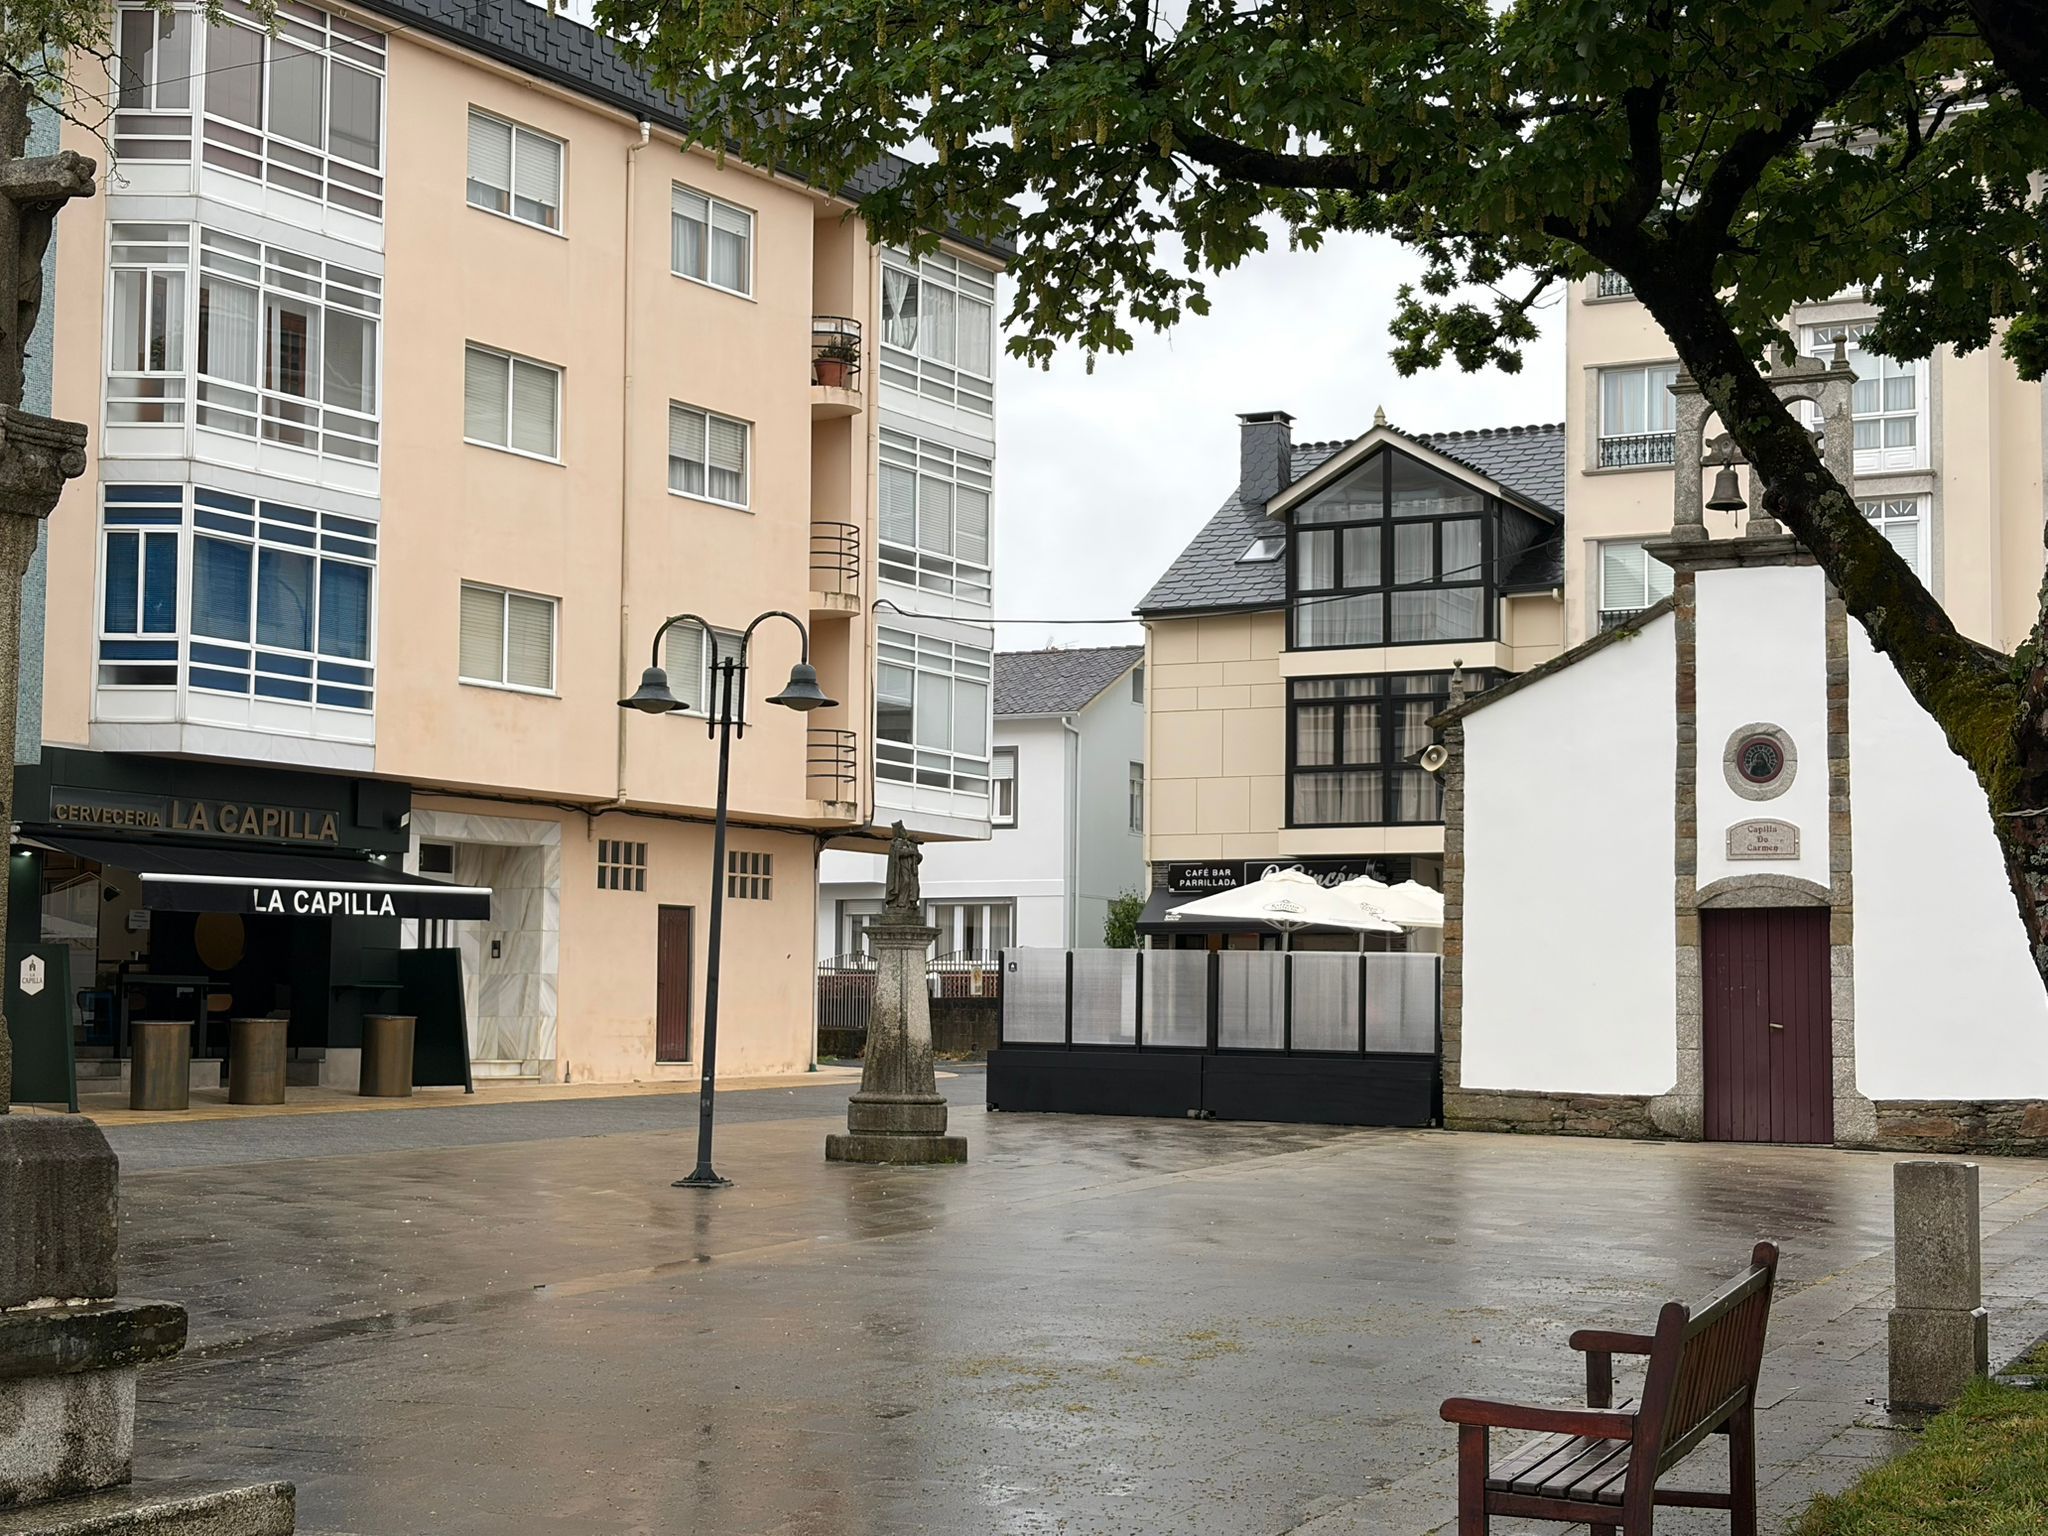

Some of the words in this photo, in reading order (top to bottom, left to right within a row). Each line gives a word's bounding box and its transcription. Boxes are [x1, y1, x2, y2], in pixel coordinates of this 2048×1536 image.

[55, 804, 161, 827] CERVECERIA
[172, 799, 210, 831] LA
[218, 804, 339, 841] CAPILLA
[1747, 825, 1778, 834] Capilla
[1746, 844, 1779, 852] Carmen
[1185, 867, 1209, 877] CAFÉ
[1212, 868, 1231, 877] BAR
[1179, 878, 1237, 887] PARRILLADA
[253, 888, 285, 913] LA
[293, 890, 396, 916] CAPILLA
